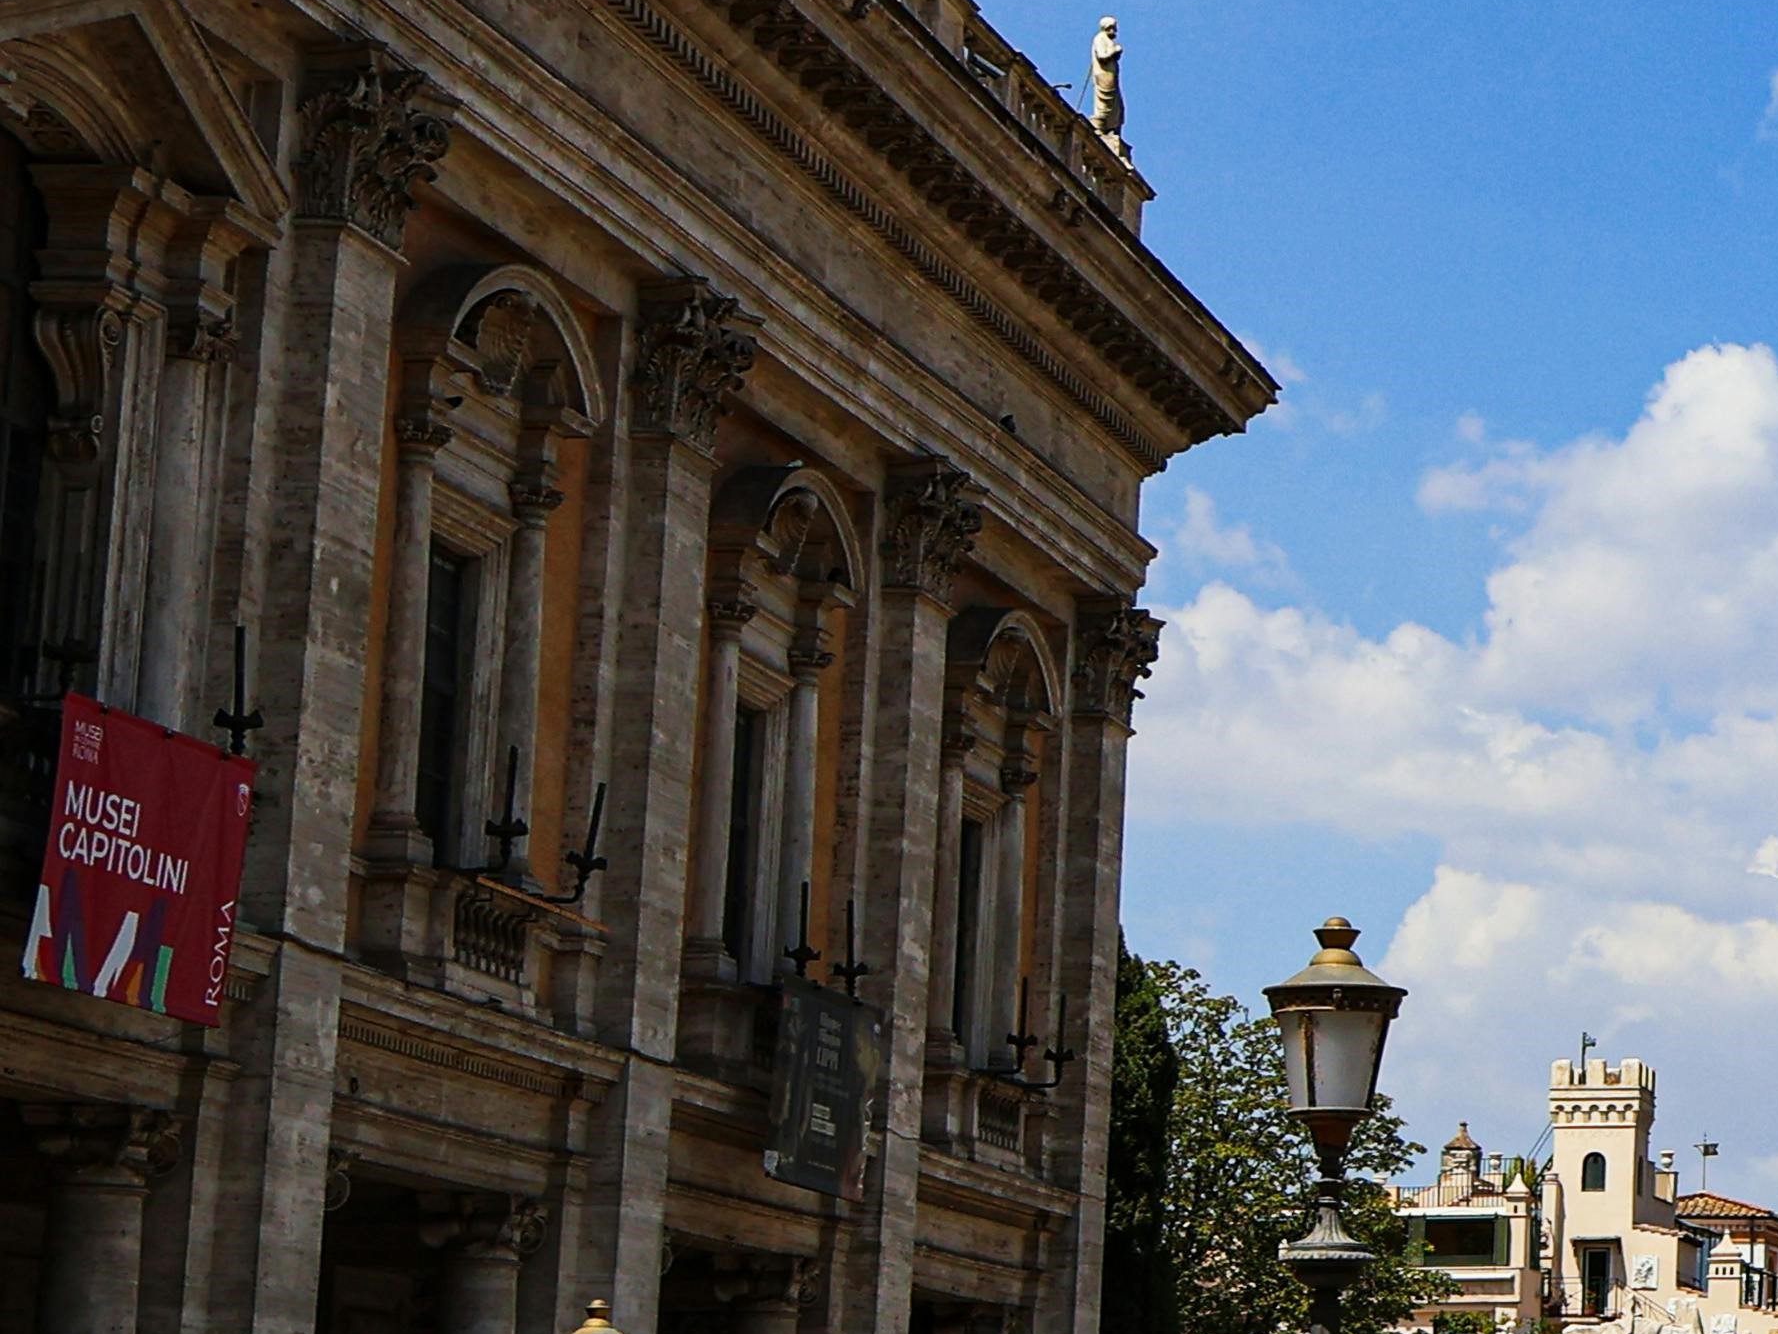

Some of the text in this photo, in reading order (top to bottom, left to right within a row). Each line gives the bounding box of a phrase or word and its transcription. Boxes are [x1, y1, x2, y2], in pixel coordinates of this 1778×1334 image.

[65, 780, 140, 838] MUSEI
[59, 822, 188, 895] CAPITOLINI
[205, 900, 235, 1006] ROMA
